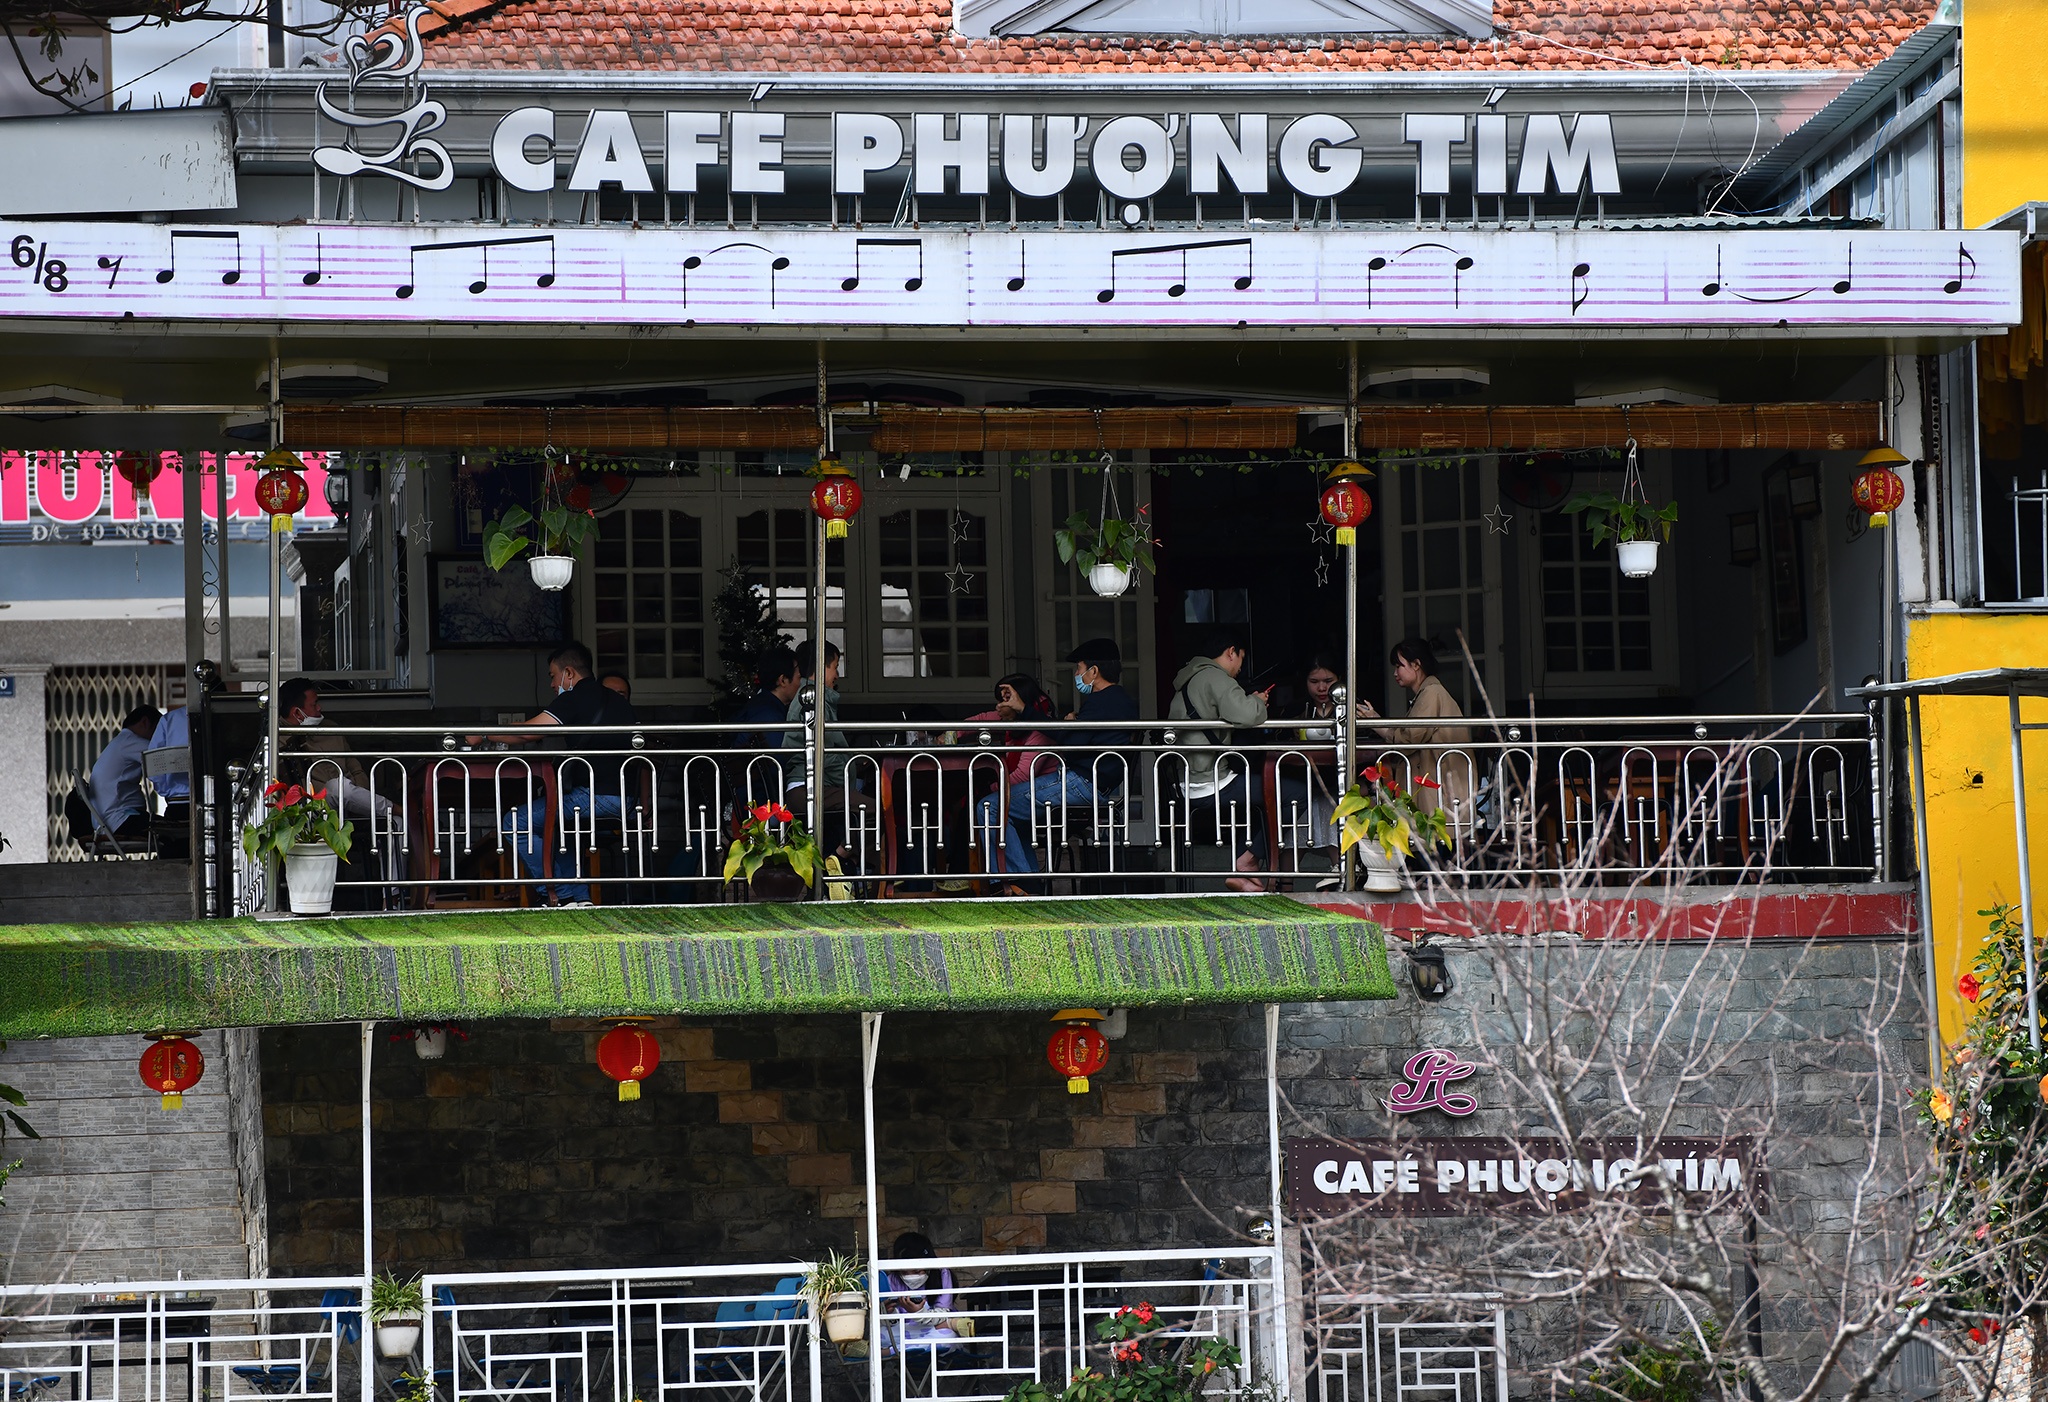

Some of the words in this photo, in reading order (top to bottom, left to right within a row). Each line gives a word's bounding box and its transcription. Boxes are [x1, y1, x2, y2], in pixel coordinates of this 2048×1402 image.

[490, 82, 787, 195] CAFÉ
[831, 111, 1364, 229] PHƯỢNG
[1401, 86, 1622, 197] TÍM
[11, 235, 68, 292] 6/8
[1313, 1153, 1420, 1194] CAFÉ
[1658, 1151, 1744, 1192] TÍM
